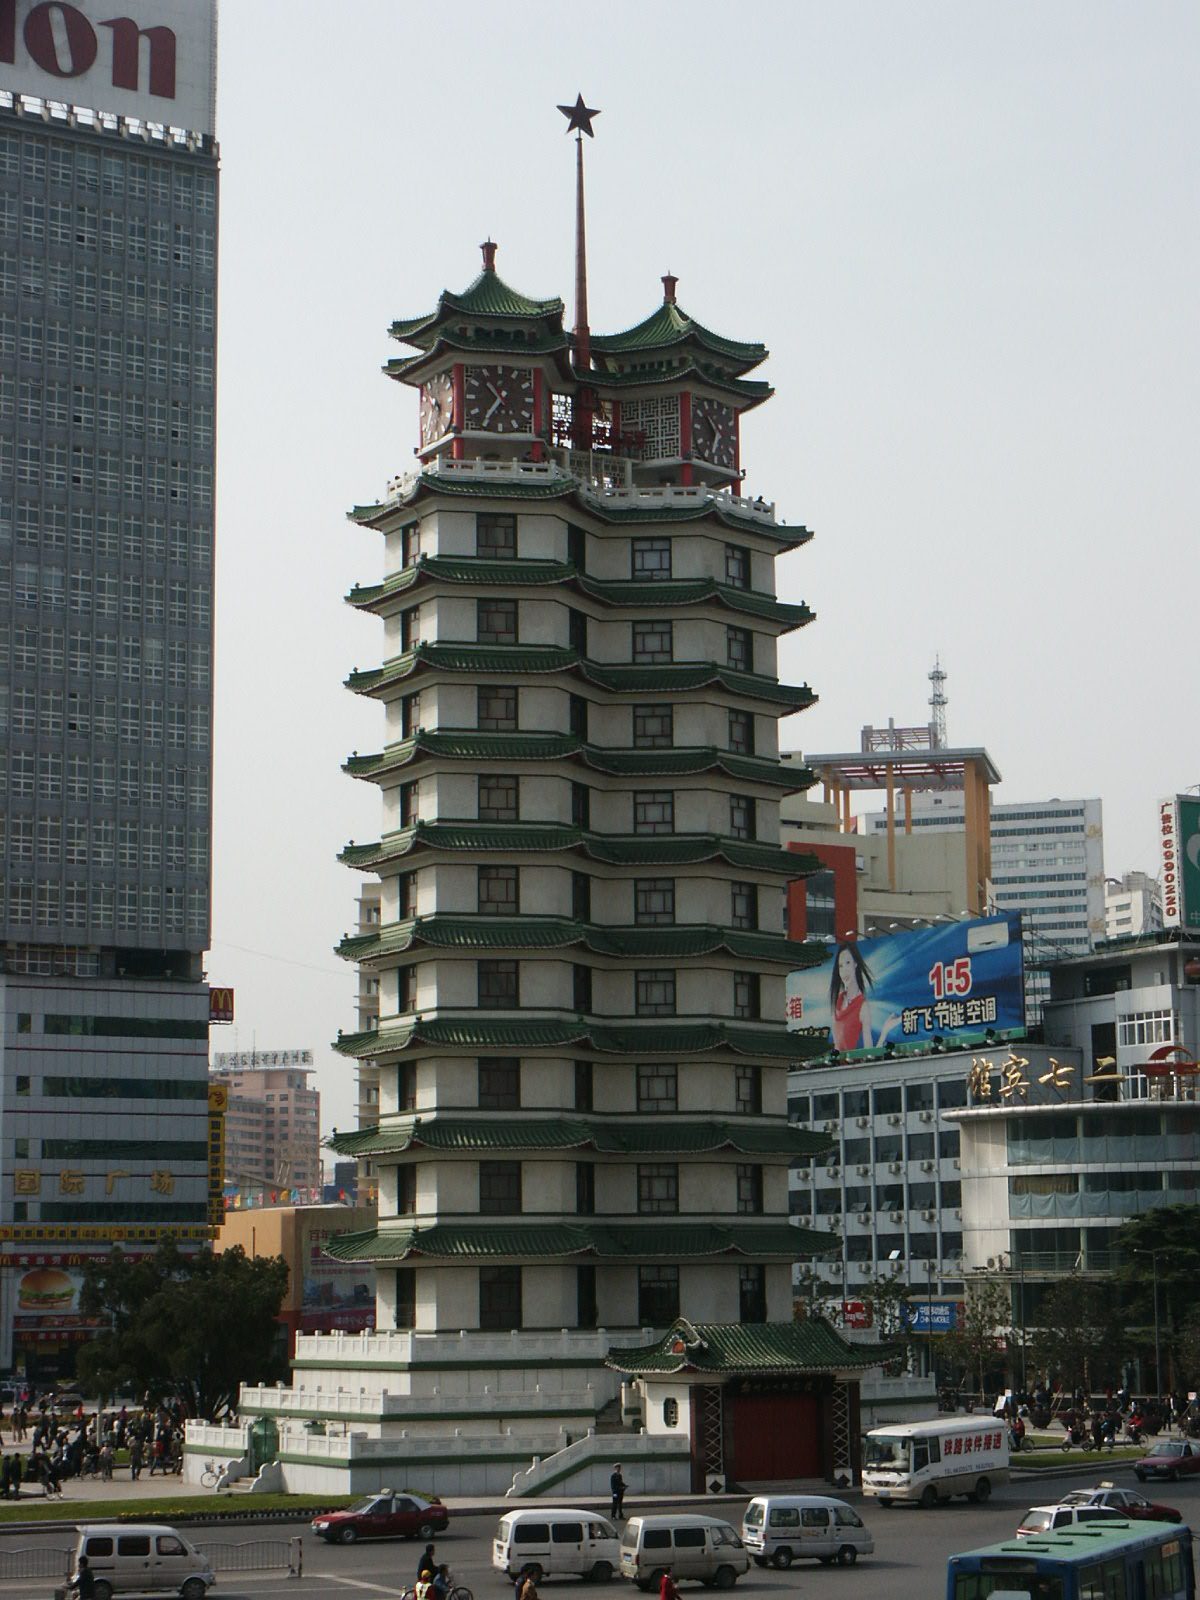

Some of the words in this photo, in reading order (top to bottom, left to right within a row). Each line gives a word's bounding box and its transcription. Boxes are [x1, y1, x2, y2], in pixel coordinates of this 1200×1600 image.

[1162, 839, 1177, 917] 6990220
[929, 957, 973, 999] 1:5
[902, 996, 997, 1035] 新飞节能空调
[14, 1168, 176, 1196] 国际广场
